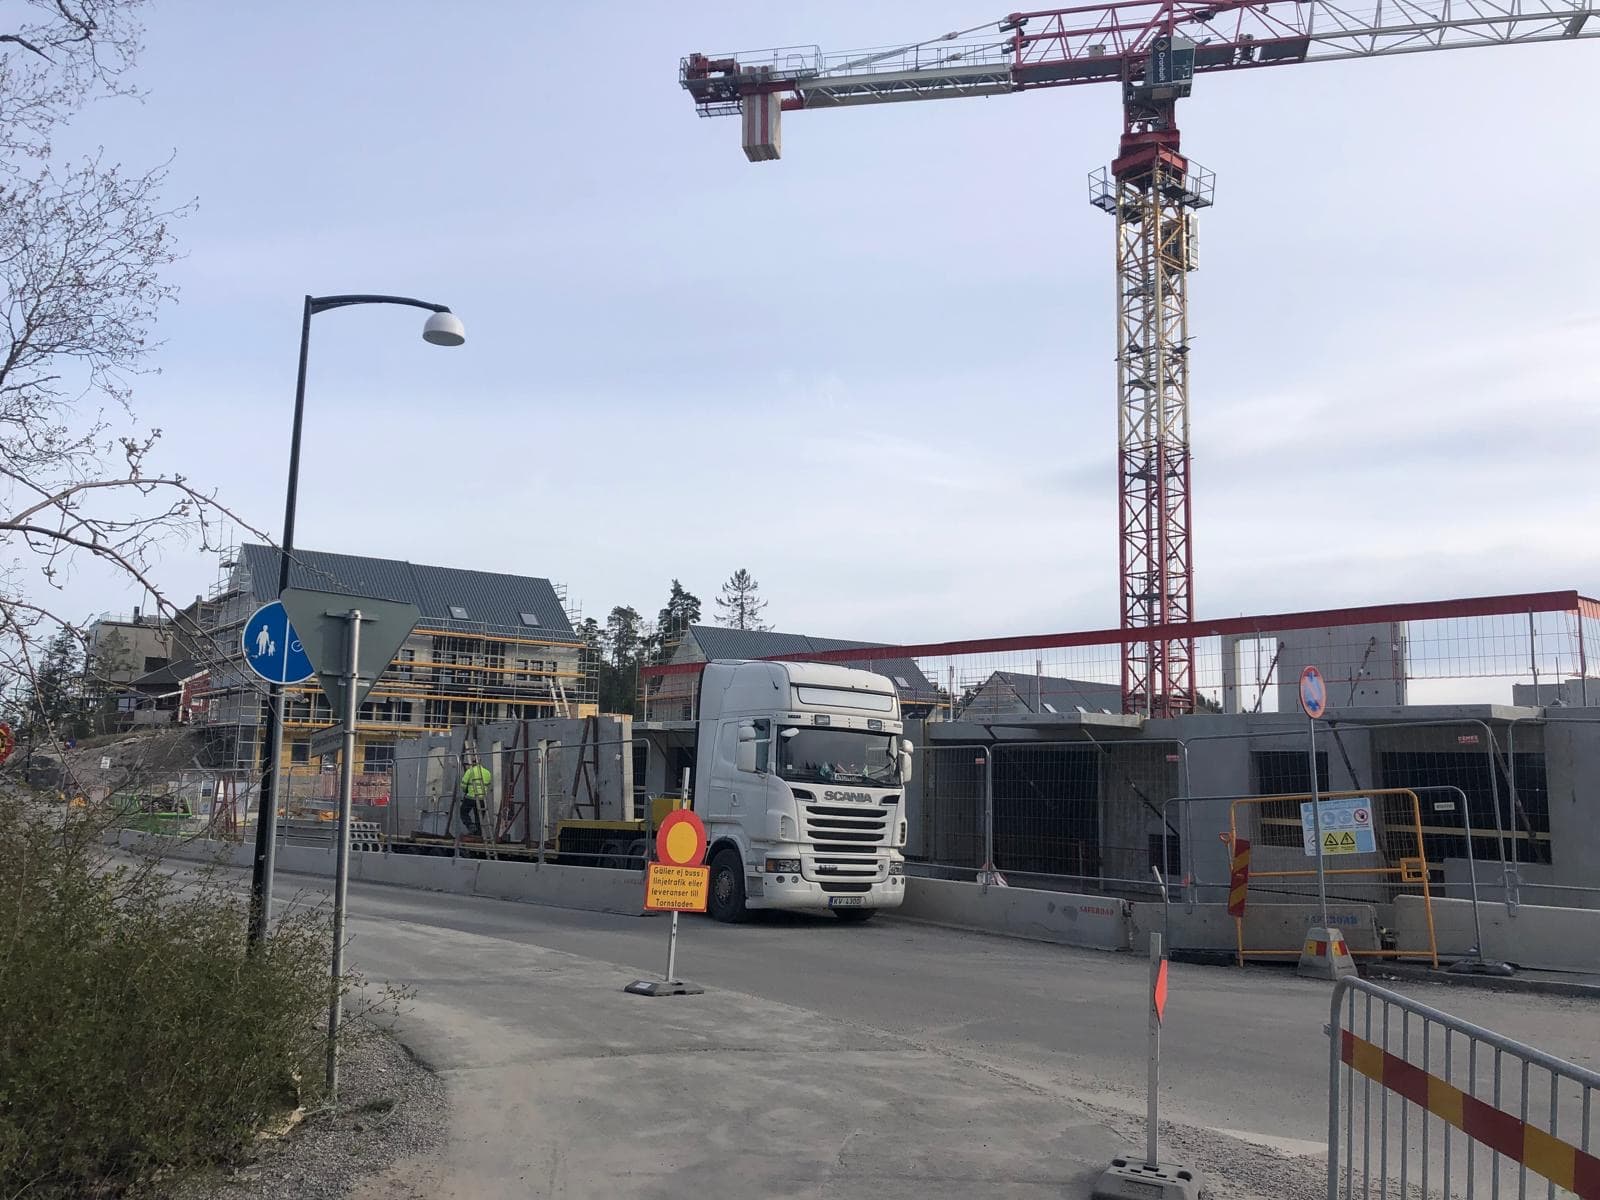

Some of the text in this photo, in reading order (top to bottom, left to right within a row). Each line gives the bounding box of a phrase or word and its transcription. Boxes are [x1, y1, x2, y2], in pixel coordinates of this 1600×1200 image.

[824, 790, 872, 803] SCANIA
[676, 869, 684, 877] ej
[685, 868, 700, 877] buss
[653, 876, 686, 887] linjetrafik
[688, 879, 703, 887] eller
[651, 887, 699, 897] leveranser till
